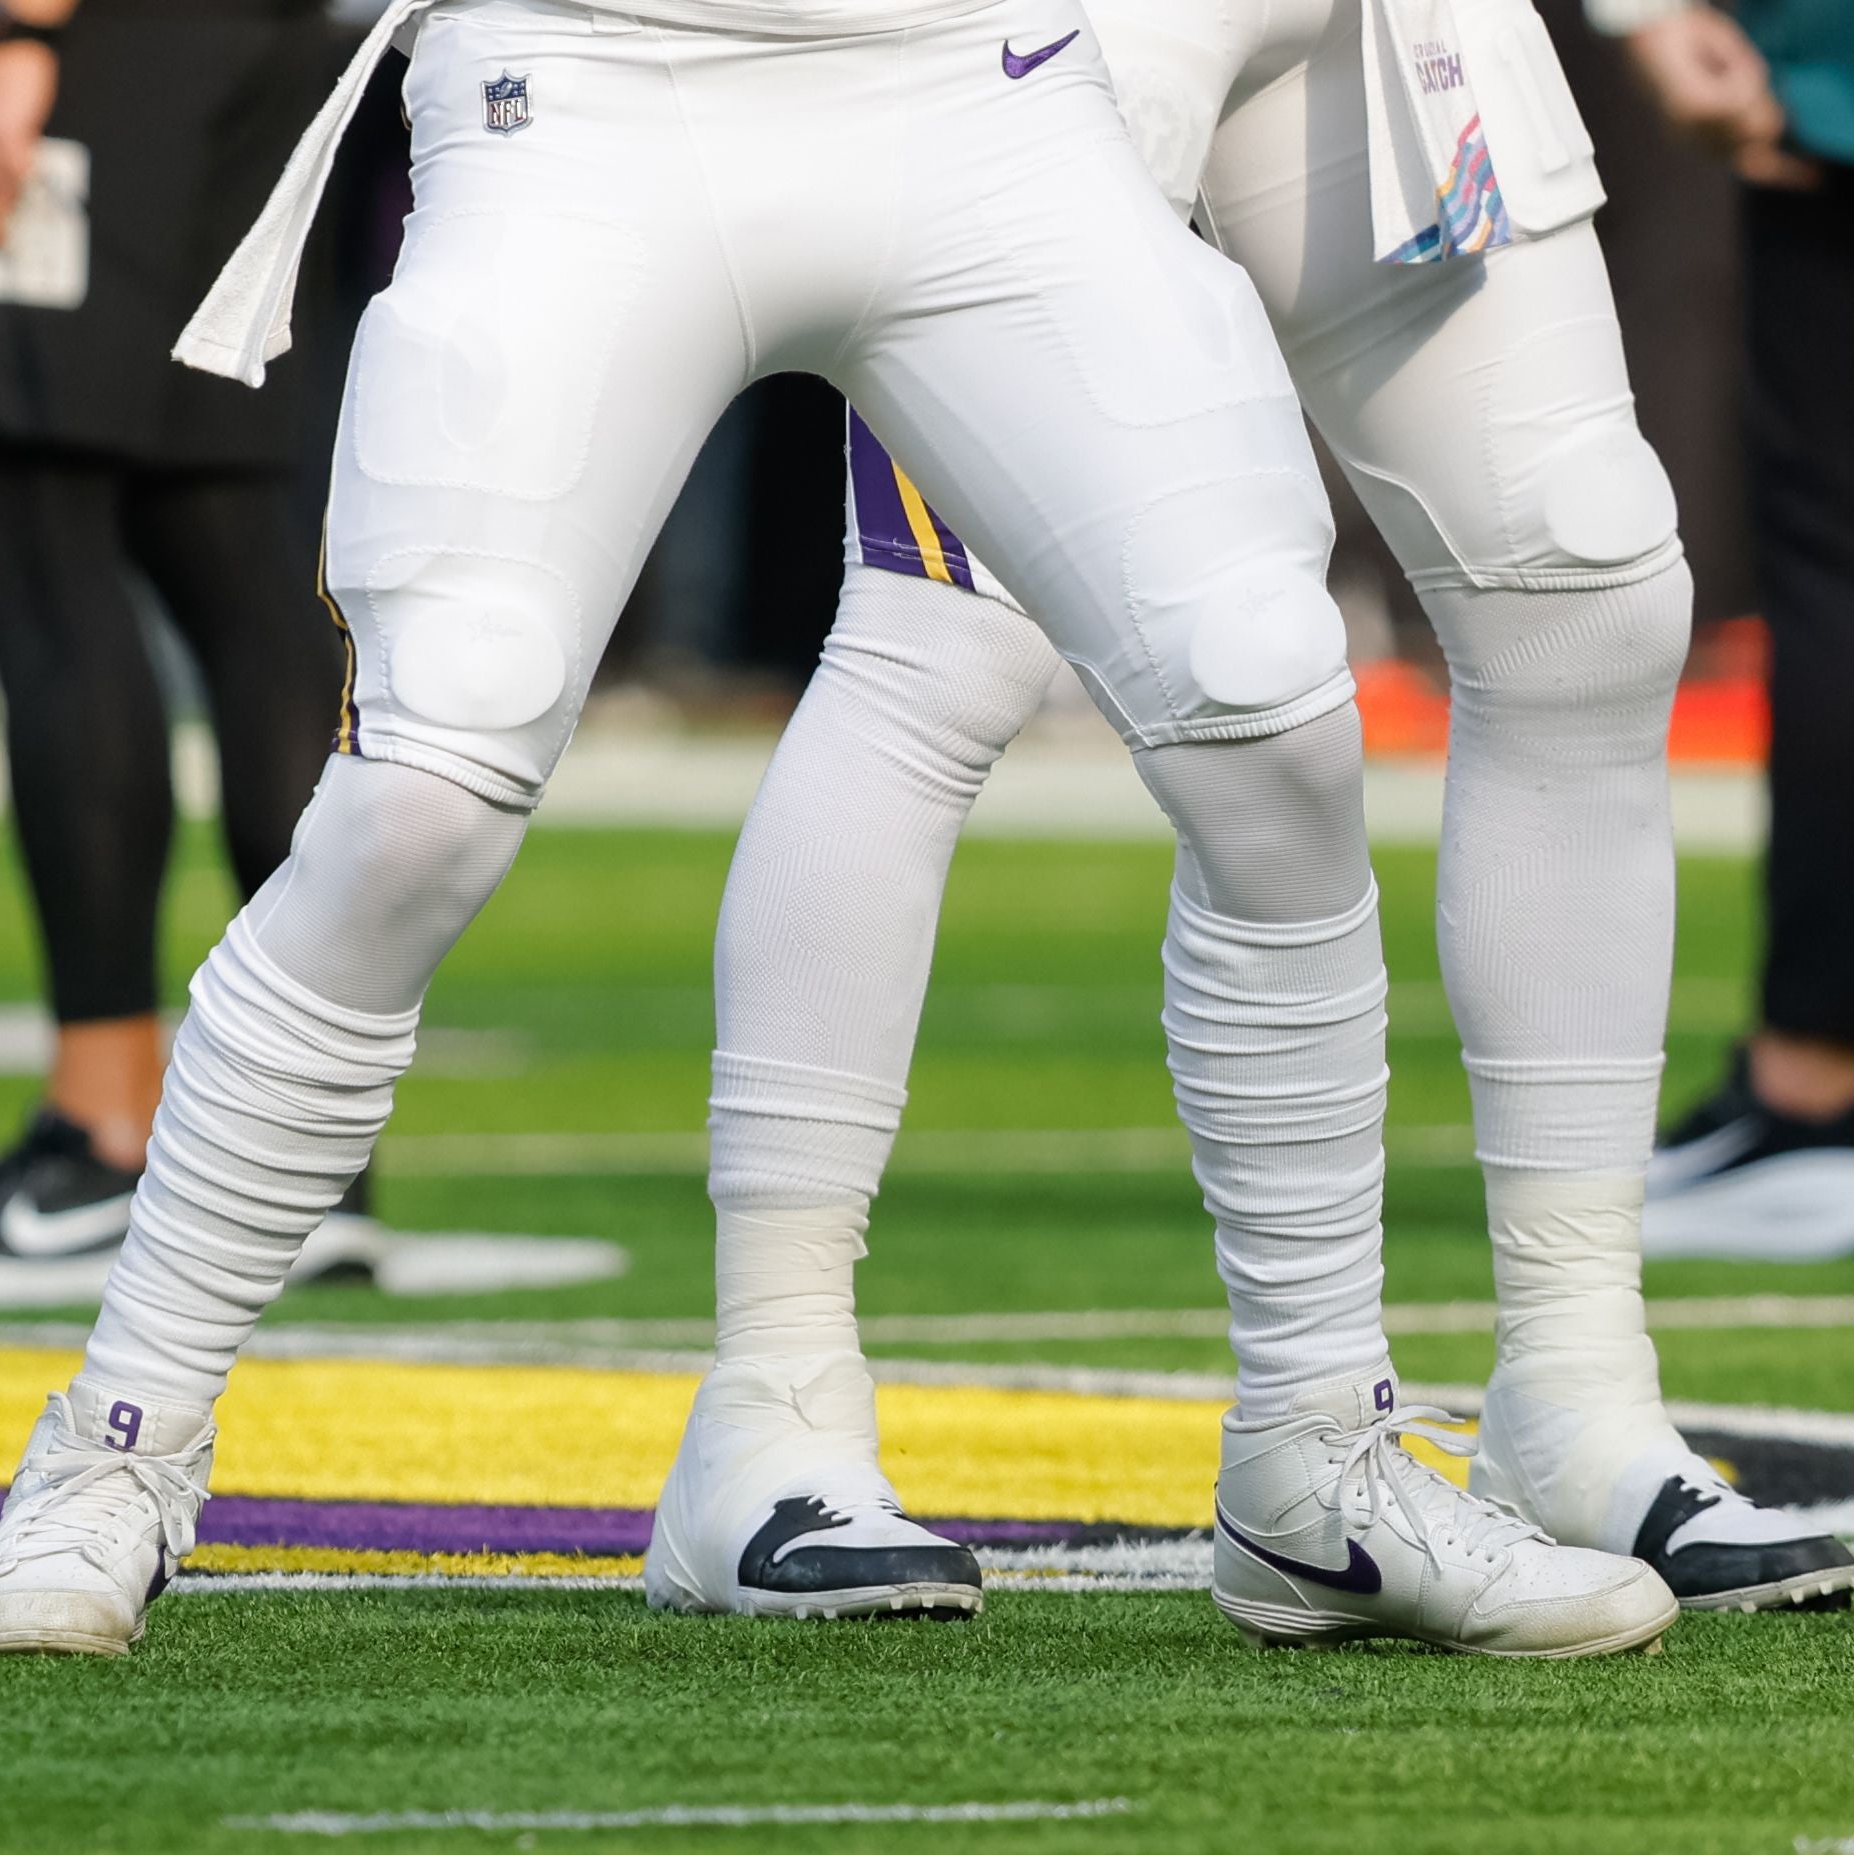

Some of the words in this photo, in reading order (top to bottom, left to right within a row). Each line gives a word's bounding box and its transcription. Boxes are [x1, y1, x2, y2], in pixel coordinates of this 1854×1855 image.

[1415, 53, 1465, 95] CATCH
[489, 98, 527, 126] NFL
[1373, 1378, 1394, 1415] 9
[105, 1400, 143, 1452] 9
